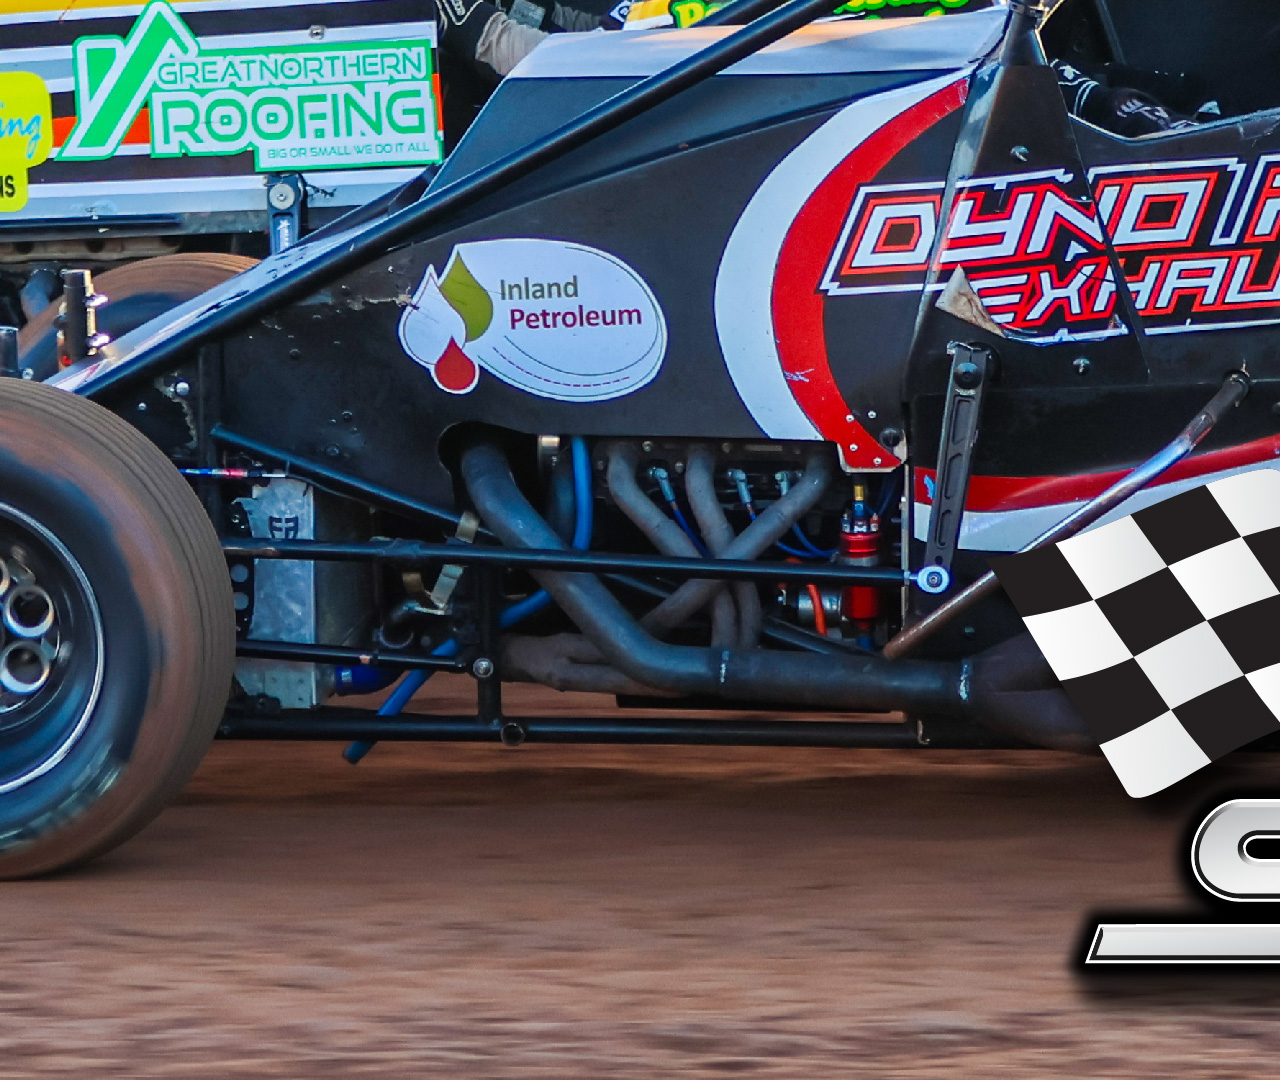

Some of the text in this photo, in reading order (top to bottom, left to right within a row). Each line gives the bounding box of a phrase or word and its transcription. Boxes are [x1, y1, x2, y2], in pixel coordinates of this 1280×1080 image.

[158, 50, 422, 85] GREATNORTHERN
[163, 89, 427, 145] ROOFING
[267, 142, 430, 159] BIG OR SMALL WE DO IT ALL
[500, 274, 579, 301] Inland
[509, 304, 643, 331] Petroleum
